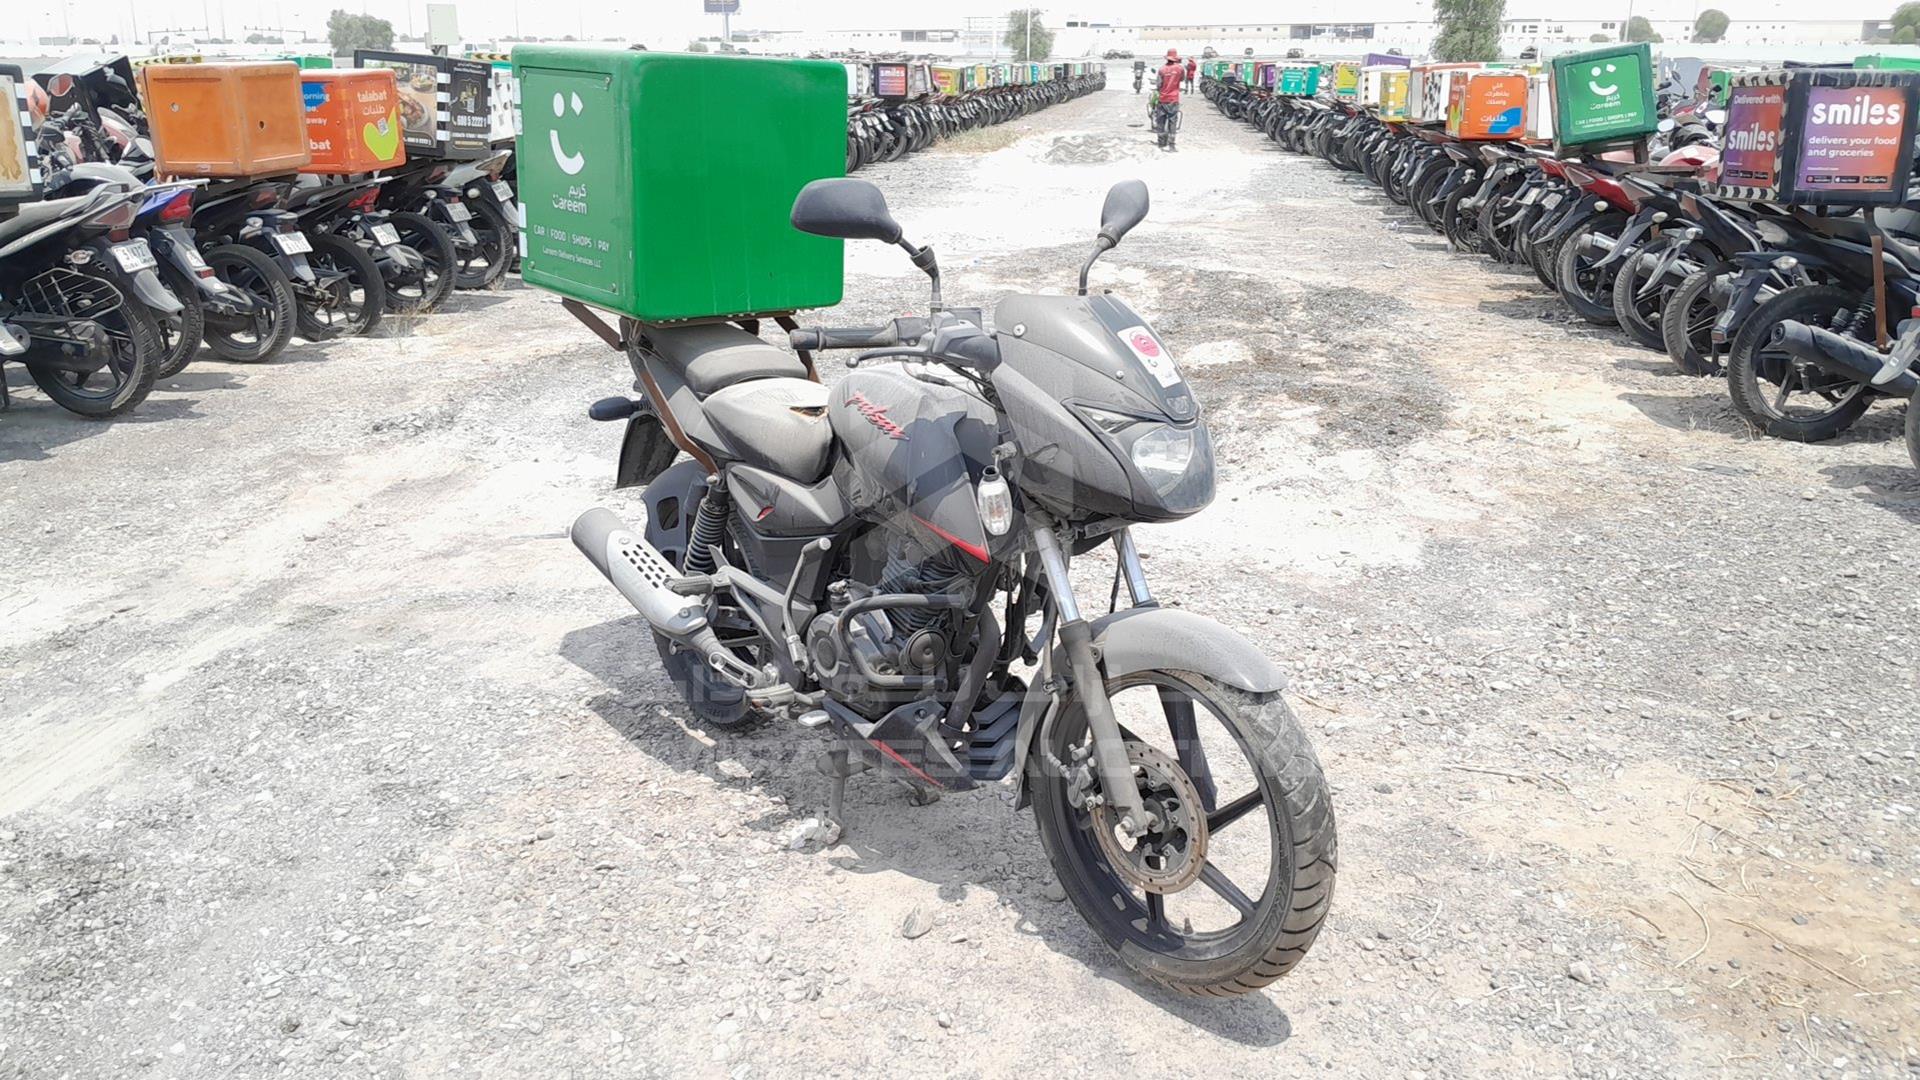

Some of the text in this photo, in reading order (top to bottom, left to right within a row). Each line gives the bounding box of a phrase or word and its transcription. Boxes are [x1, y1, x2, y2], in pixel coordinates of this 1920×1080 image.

[303, 92, 330, 102] orning
[357, 89, 388, 102] talabat
[1734, 95, 1781, 105] Delivered with
[363, 104, 385, 115] طلبات
[1811, 94, 1901, 125] smiles
[1728, 122, 1775, 151] smiles
[1808, 136, 1897, 146] delivers your food
[1807, 148, 1874, 158] and groceries
[568, 183, 587, 199] كريم
[552, 194, 588, 215] Careem
[533, 224, 610, 252] CAR FOOD SHOPS PAY
